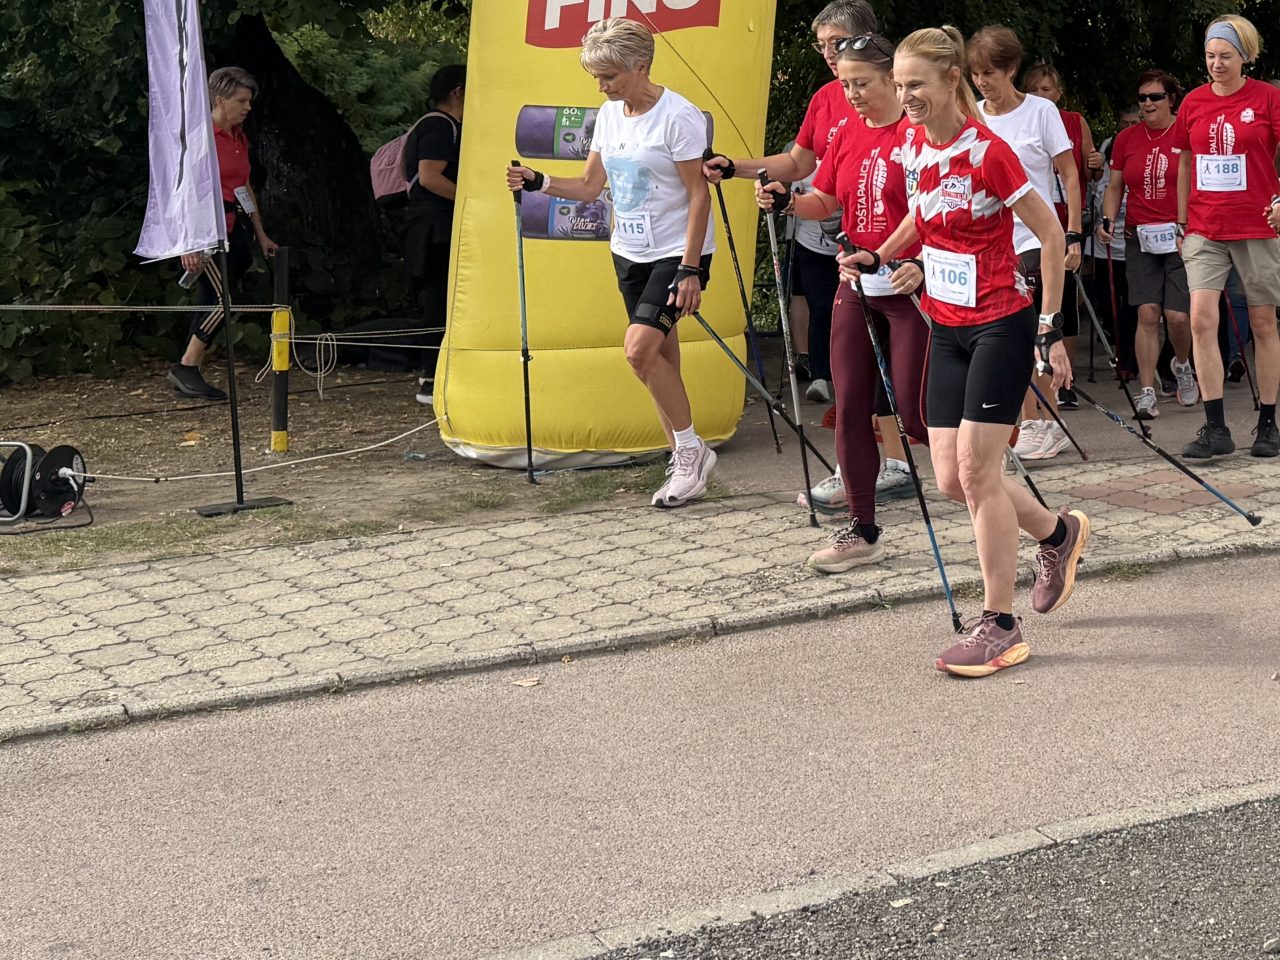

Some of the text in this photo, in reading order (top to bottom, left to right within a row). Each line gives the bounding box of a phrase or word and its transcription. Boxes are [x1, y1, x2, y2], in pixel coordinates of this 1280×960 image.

[1209, 123, 1218, 155] PALICE
[1214, 162, 1240, 175] 188
[620, 221, 645, 235] 115
[1153, 232, 1175, 243] 183
[939, 268, 968, 286] 106
